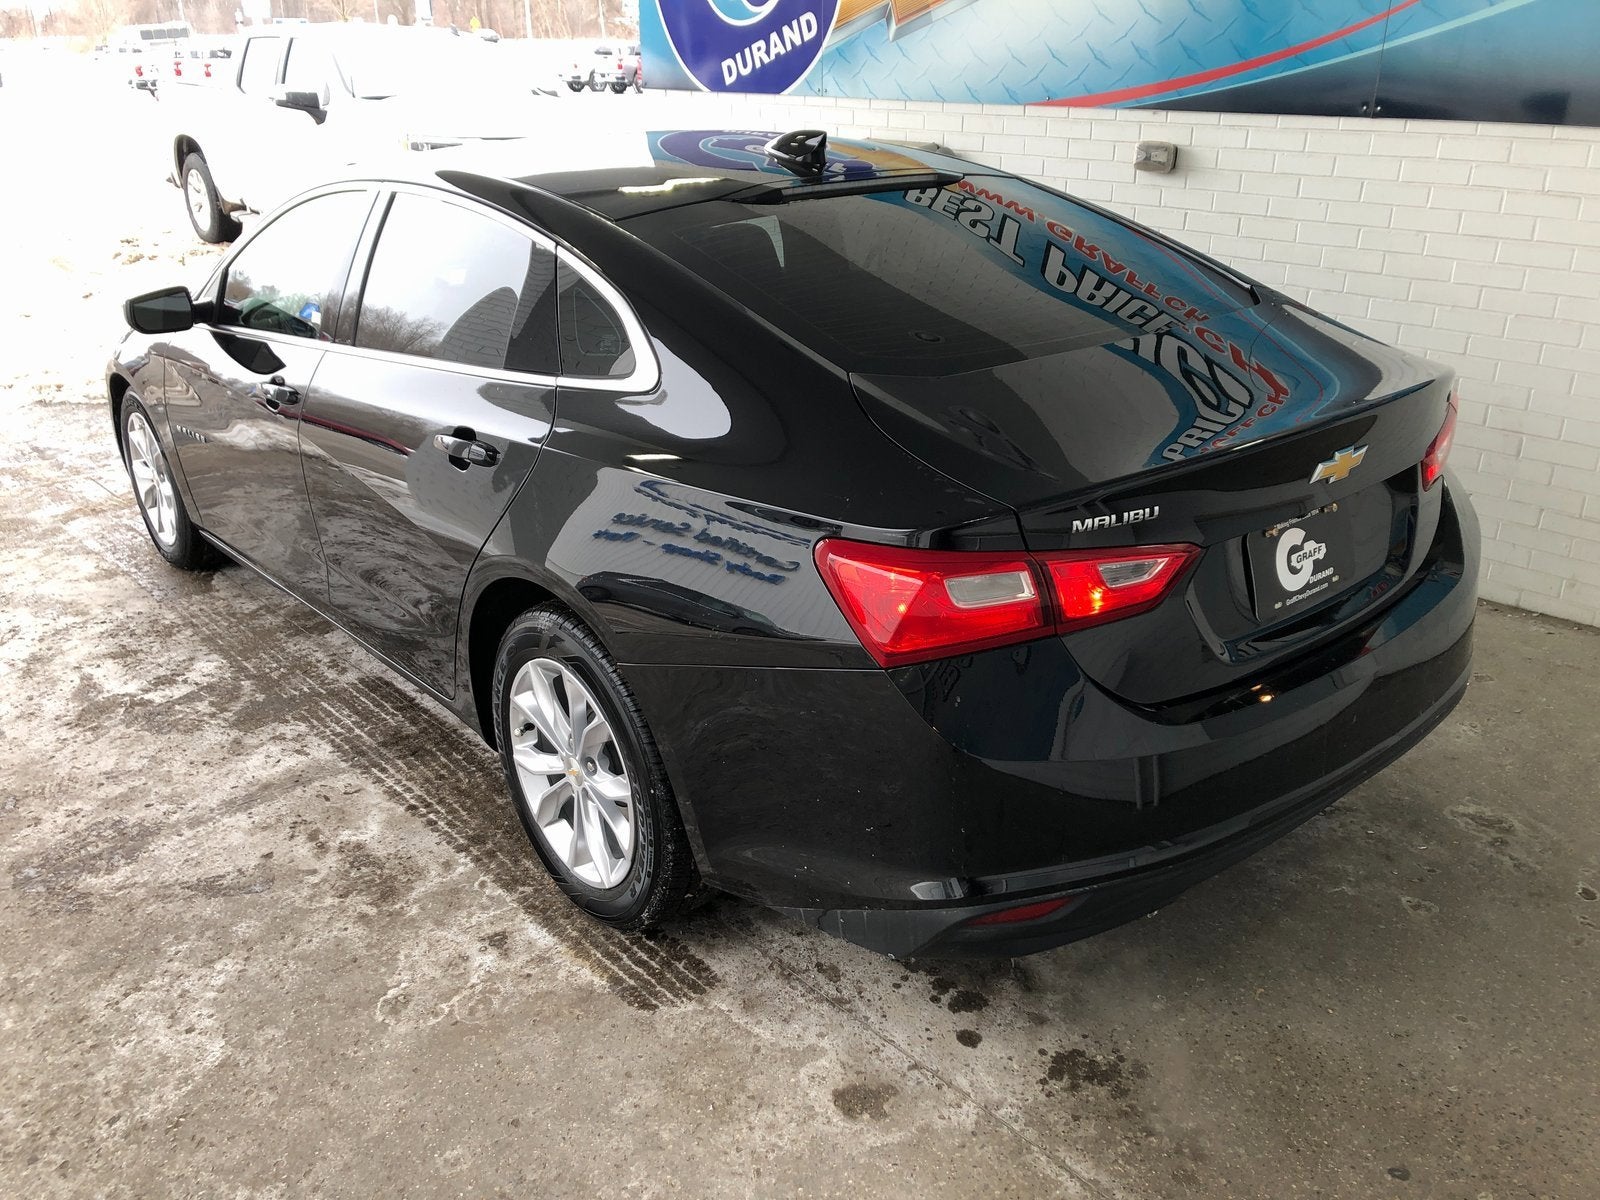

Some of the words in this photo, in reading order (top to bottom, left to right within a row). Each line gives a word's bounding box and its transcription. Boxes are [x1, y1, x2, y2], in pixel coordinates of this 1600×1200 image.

[721, 11, 818, 86] DURAND
[1071, 505, 1160, 534] MALIBU
[1296, 545, 1323, 563] GRAFF
[1309, 566, 1335, 584] DURAND
